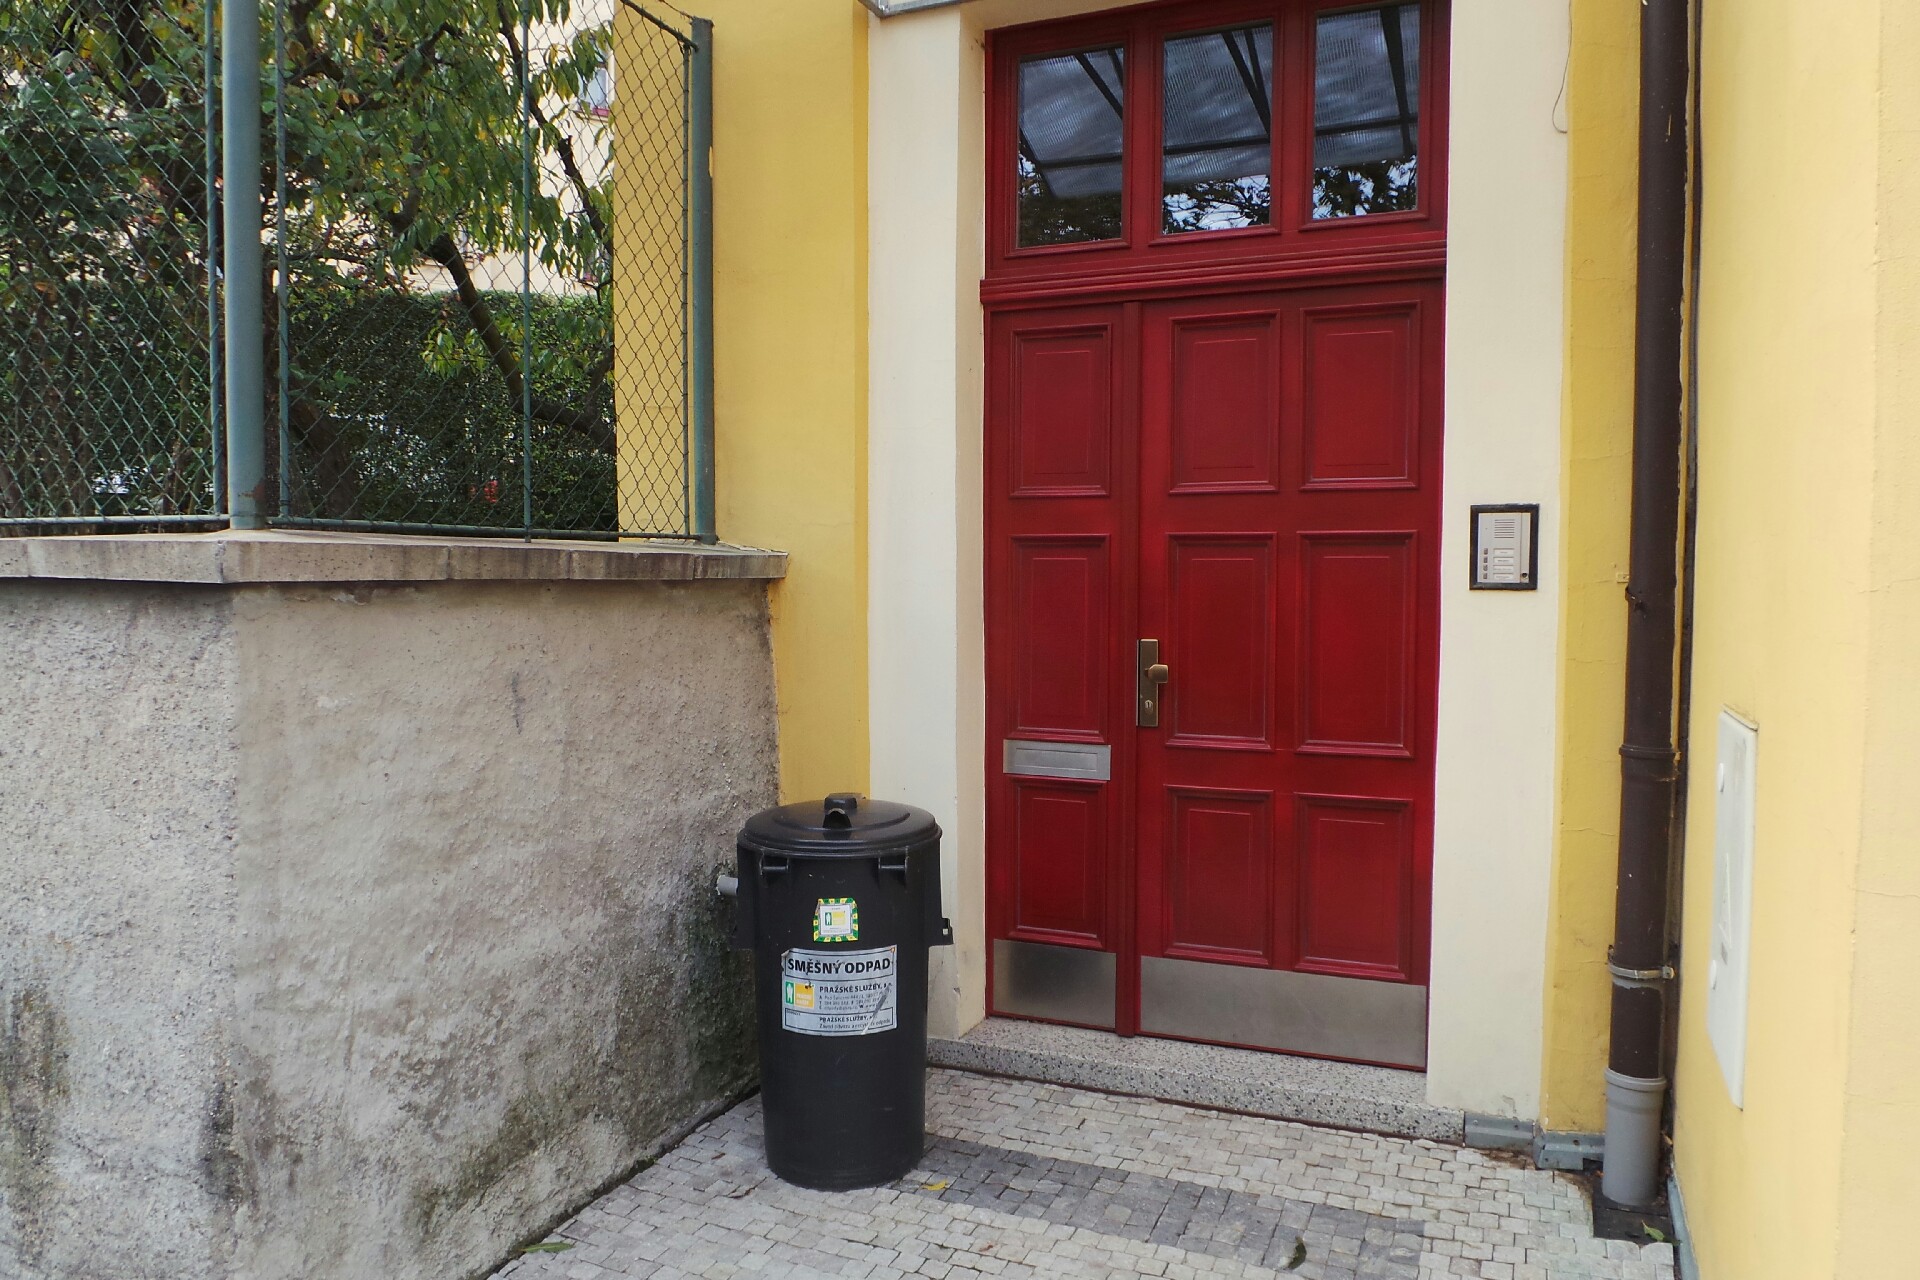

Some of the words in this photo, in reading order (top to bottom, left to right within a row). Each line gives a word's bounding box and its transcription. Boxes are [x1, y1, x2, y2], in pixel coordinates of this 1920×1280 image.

[787, 958, 841, 974] SMĚŠNÝ
[844, 957, 891, 974] ODPAD
[819, 985, 854, 993] PRAŽSKÉ
